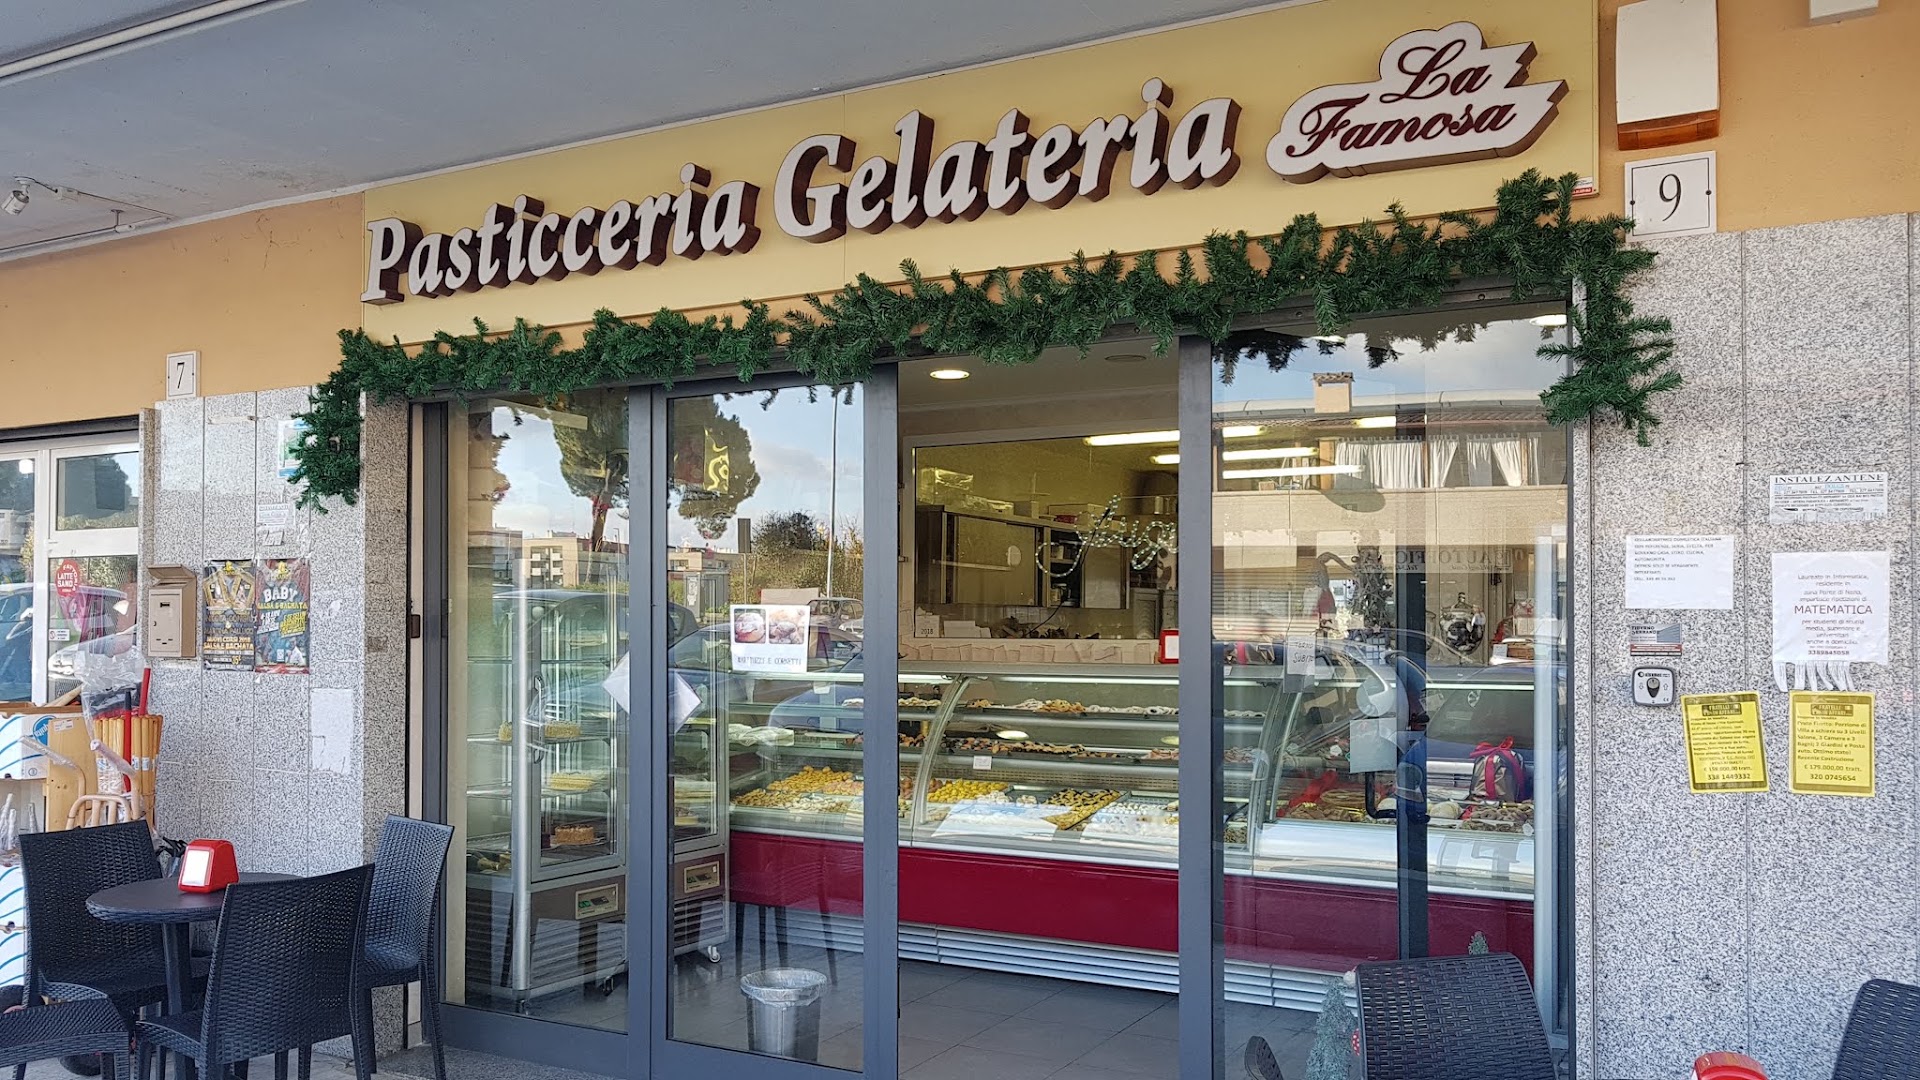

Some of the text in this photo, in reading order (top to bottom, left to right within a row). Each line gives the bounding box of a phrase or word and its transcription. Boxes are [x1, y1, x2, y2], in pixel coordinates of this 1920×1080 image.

[1379, 39, 1492, 103] La
[1286, 93, 1516, 158] Famosa
[360, 77, 1238, 304] Pasticceria Gelateria
[1658, 173, 1683, 222] 9
[176, 362, 185, 389] 7
[263, 586, 298, 602] BABY
[1794, 605, 1873, 615] MATEMATICA
